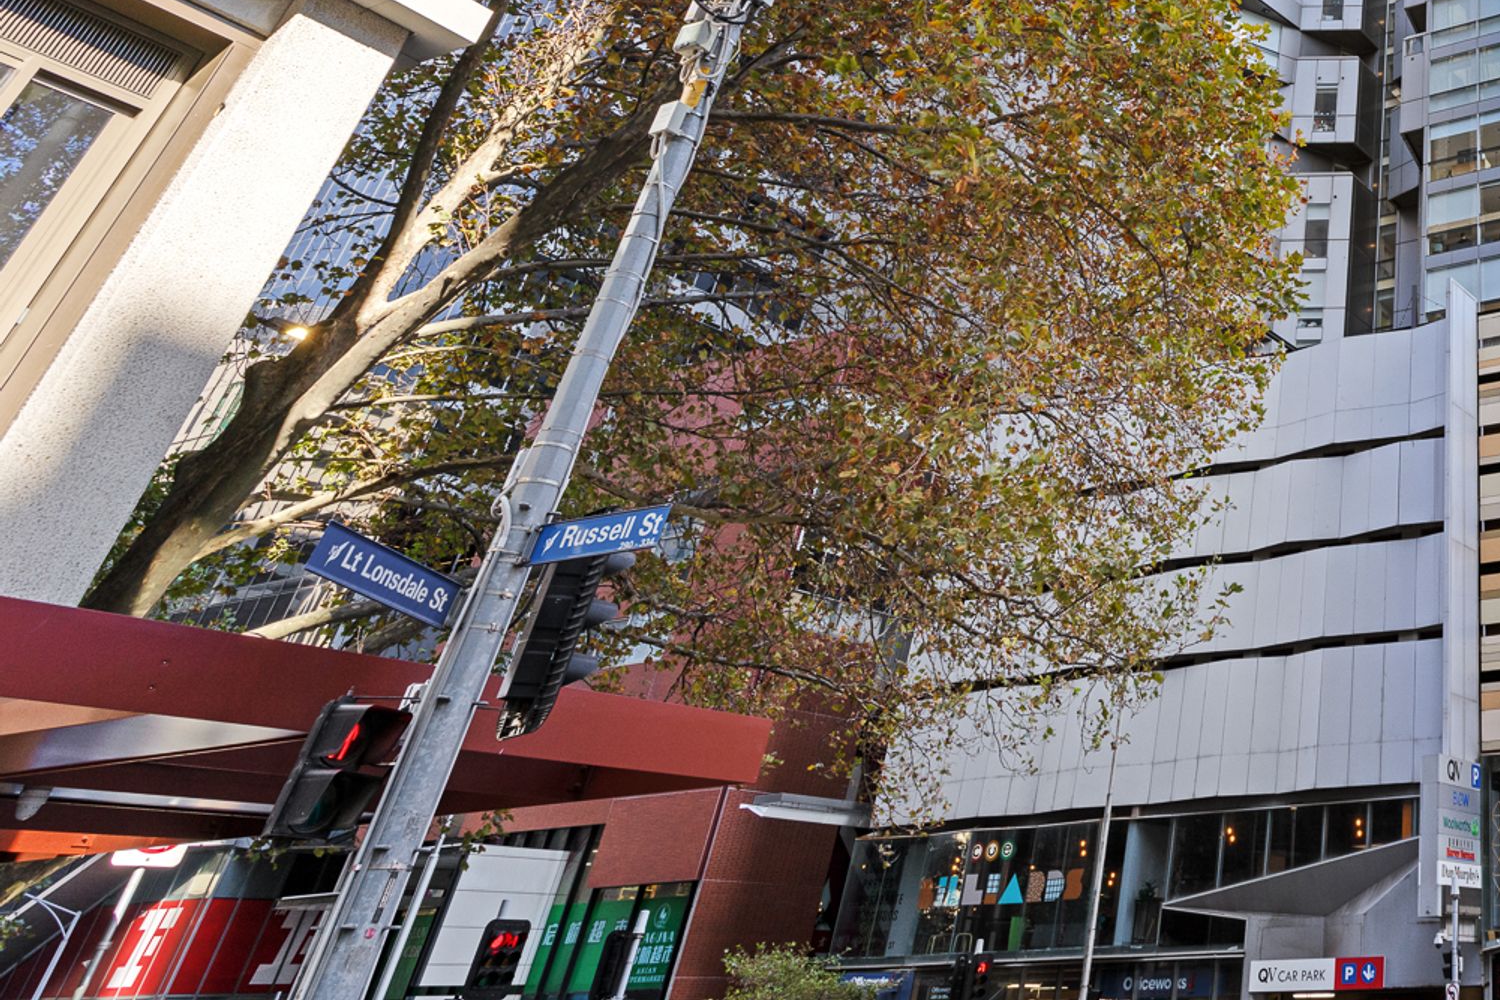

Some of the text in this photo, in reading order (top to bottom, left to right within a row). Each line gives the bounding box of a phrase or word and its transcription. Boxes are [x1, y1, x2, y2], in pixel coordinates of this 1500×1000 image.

[559, 512, 663, 549] Russell St
[341, 544, 448, 612] Lt Lonsdale St
[1258, 967, 1326, 983] QV CAR PARK
[1345, 966, 1354, 980] P
